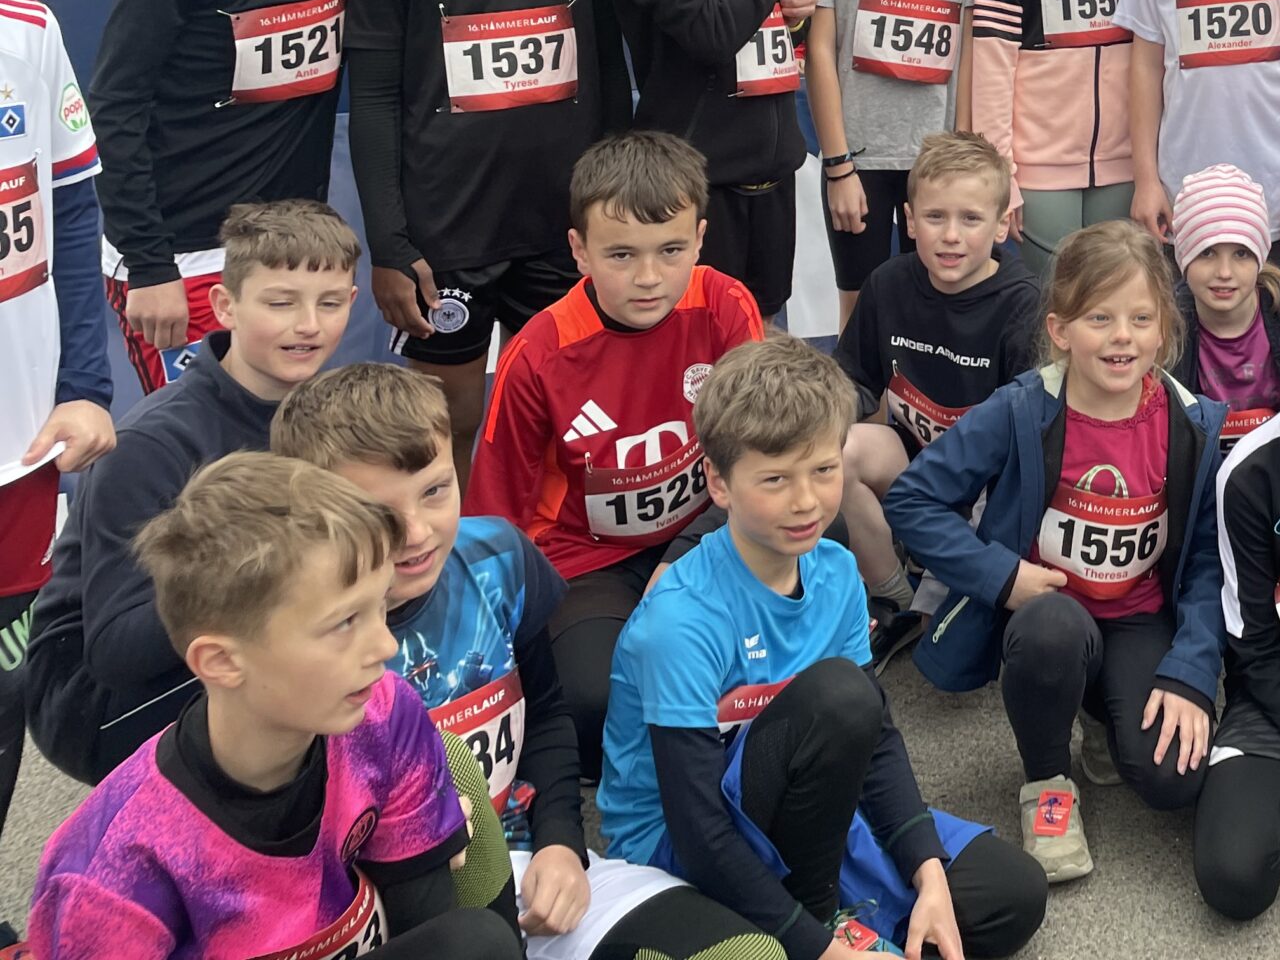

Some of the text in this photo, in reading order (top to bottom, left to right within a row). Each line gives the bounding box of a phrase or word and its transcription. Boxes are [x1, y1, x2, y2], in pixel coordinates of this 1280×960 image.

[870, 15, 951, 58] 1548
[1188, 3, 1272, 41] 1520
[255, 16, 341, 75] 1521
[462, 33, 565, 81] 1537
[749, 29, 794, 66] 15
[901, 54, 922, 65] Lara
[1207, 40, 1252, 50] Alexander
[295, 67, 319, 79] Ante
[503, 78, 539, 91] Tyrese
[891, 335, 991, 368] UNDER ARMOUR
[605, 456, 707, 526] 1528
[1058, 518, 1159, 567] 1556
[1084, 567, 1128, 580] Theresa
